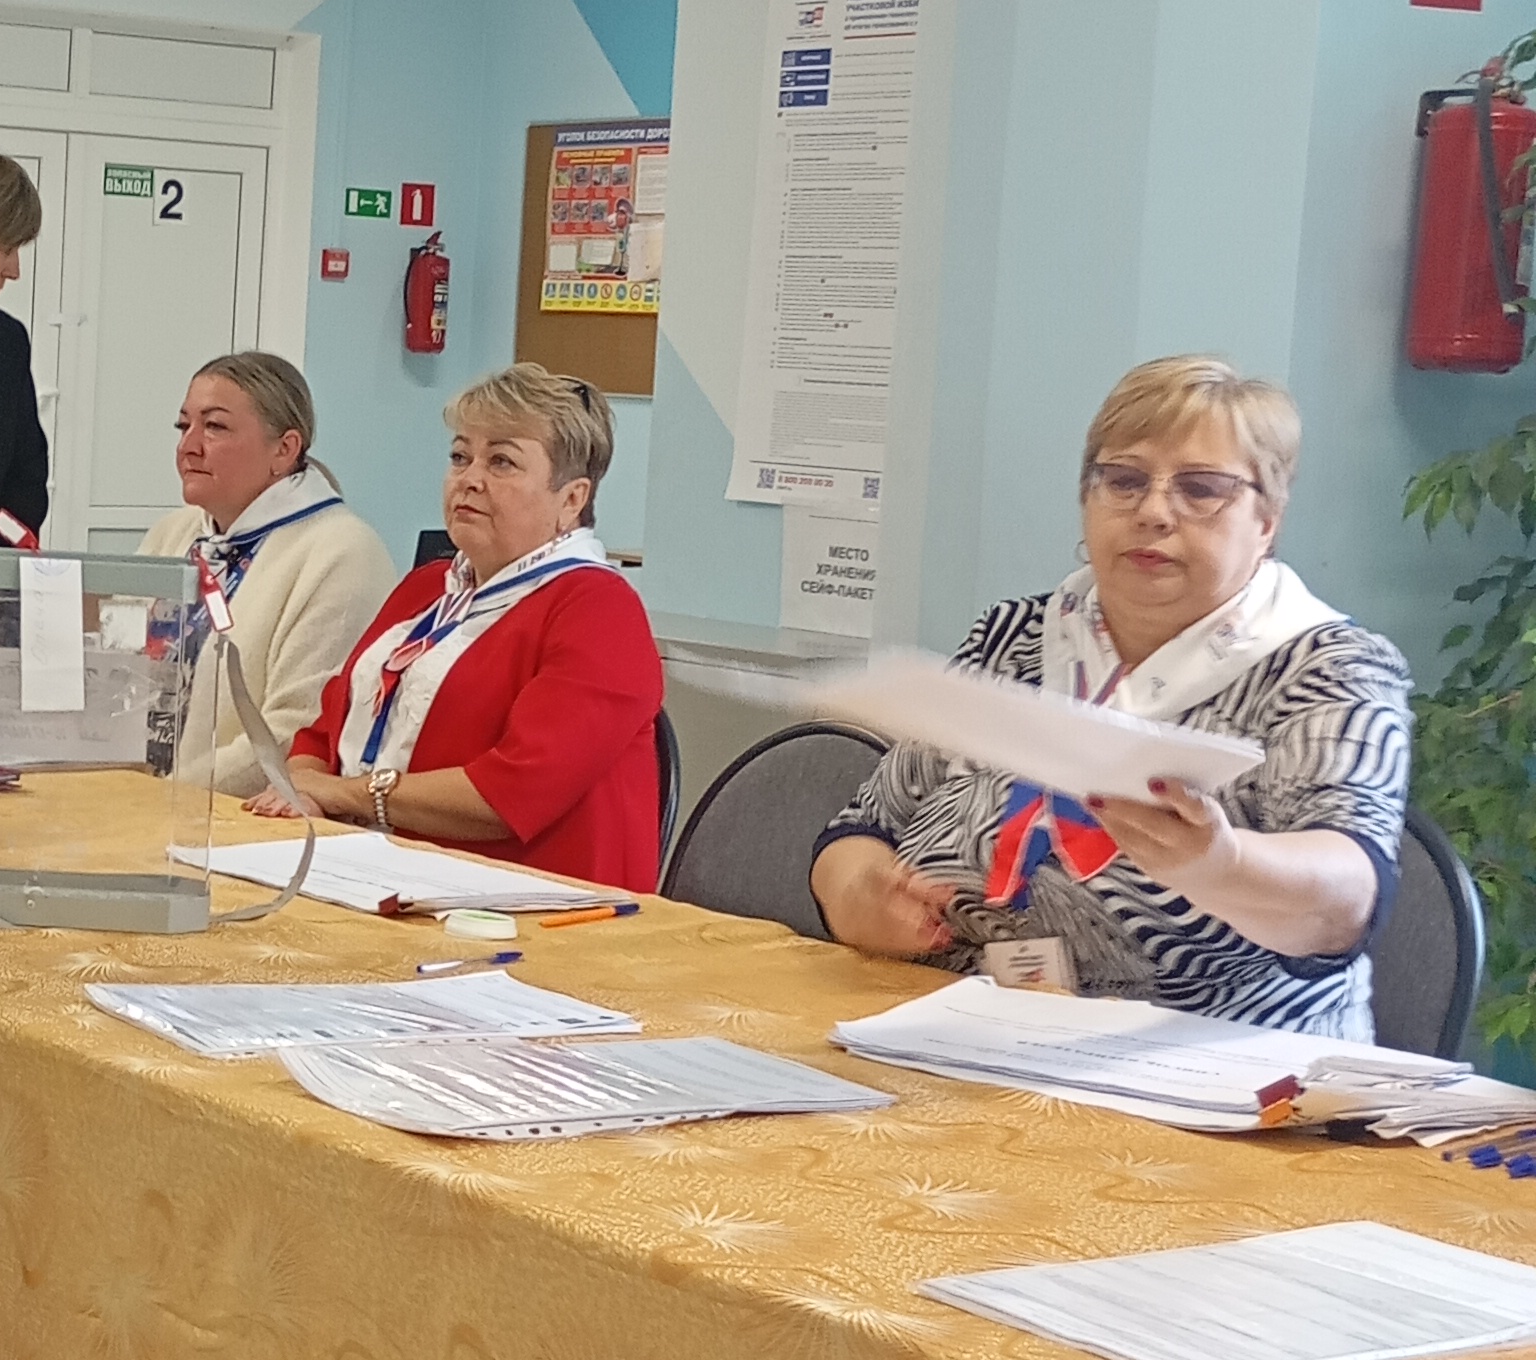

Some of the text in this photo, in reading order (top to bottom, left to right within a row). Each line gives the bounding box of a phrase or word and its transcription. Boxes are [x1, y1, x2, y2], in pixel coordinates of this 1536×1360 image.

[645, 127, 670, 141] ДОРО
[105, 178, 151, 196] ВЫХОД
[159, 179, 184, 220] 2
[828, 546, 870, 562] МЕСТО
